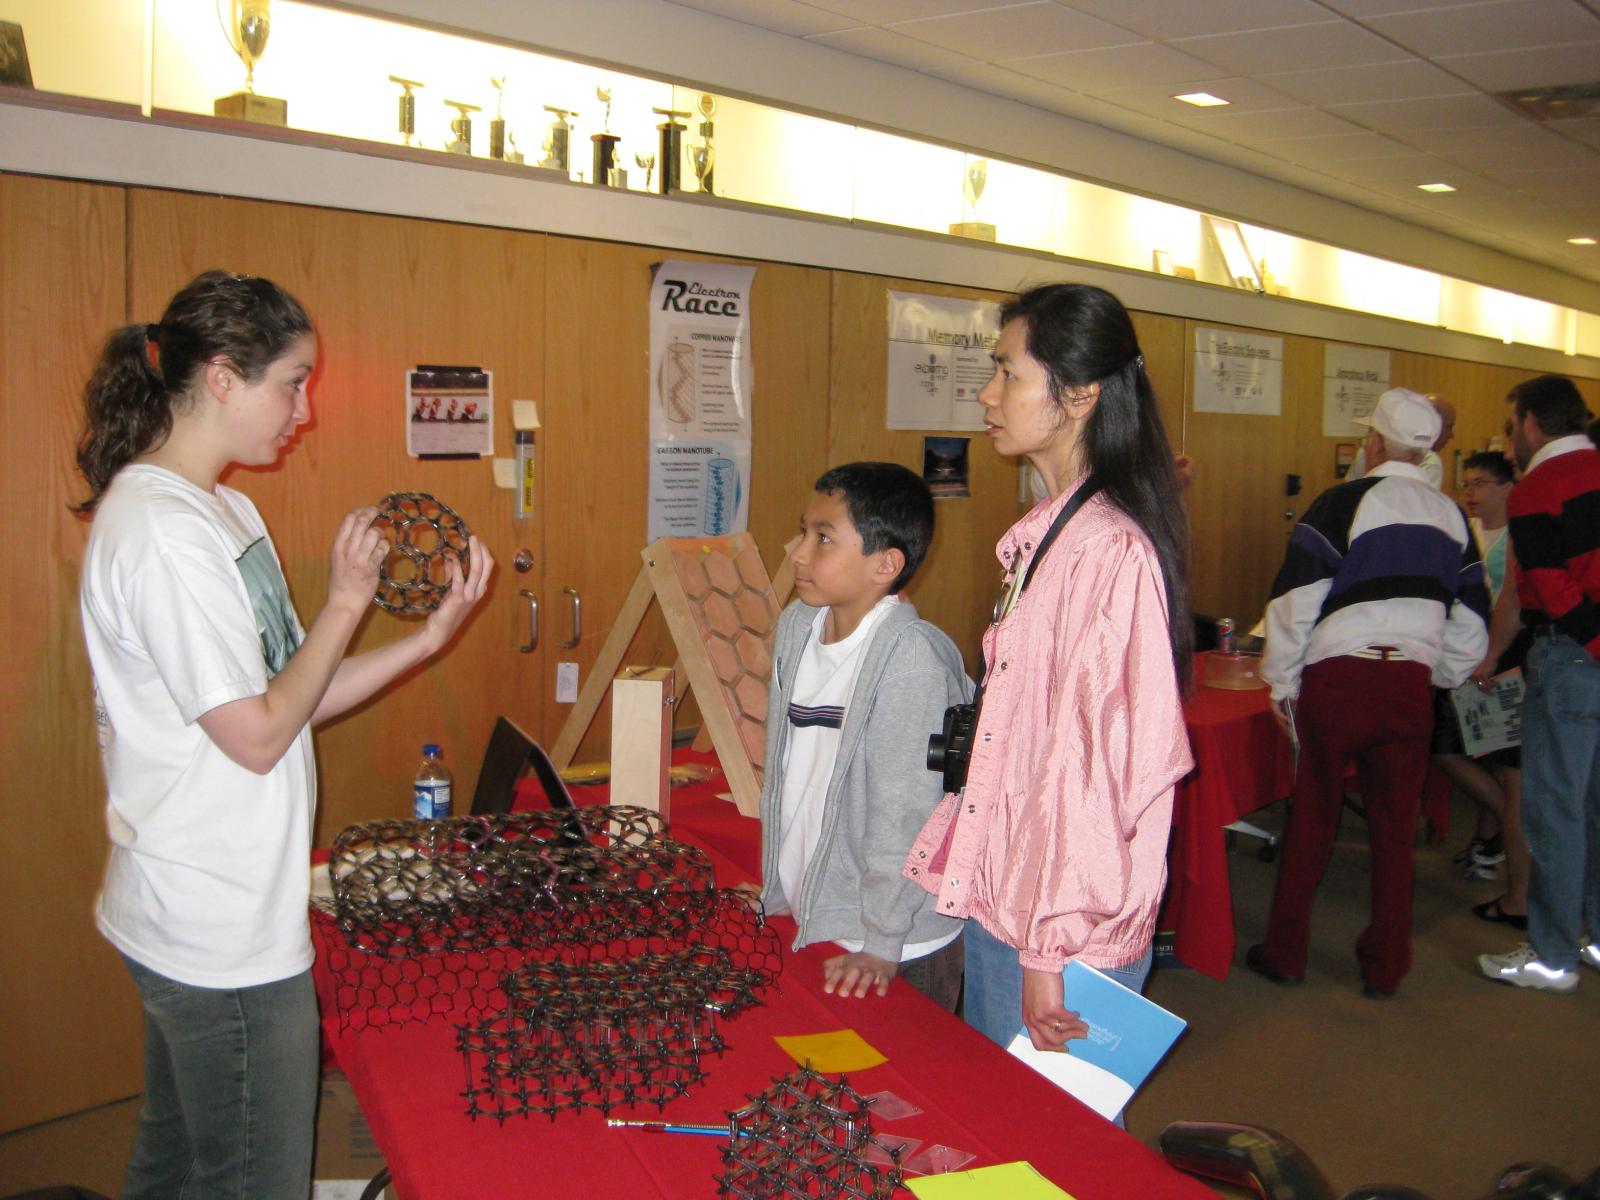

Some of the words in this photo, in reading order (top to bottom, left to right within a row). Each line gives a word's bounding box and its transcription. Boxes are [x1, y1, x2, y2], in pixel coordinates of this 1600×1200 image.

[662, 279, 741, 317] Race
[688, 281, 741, 300] Electron
[927, 328, 971, 350] Memory
